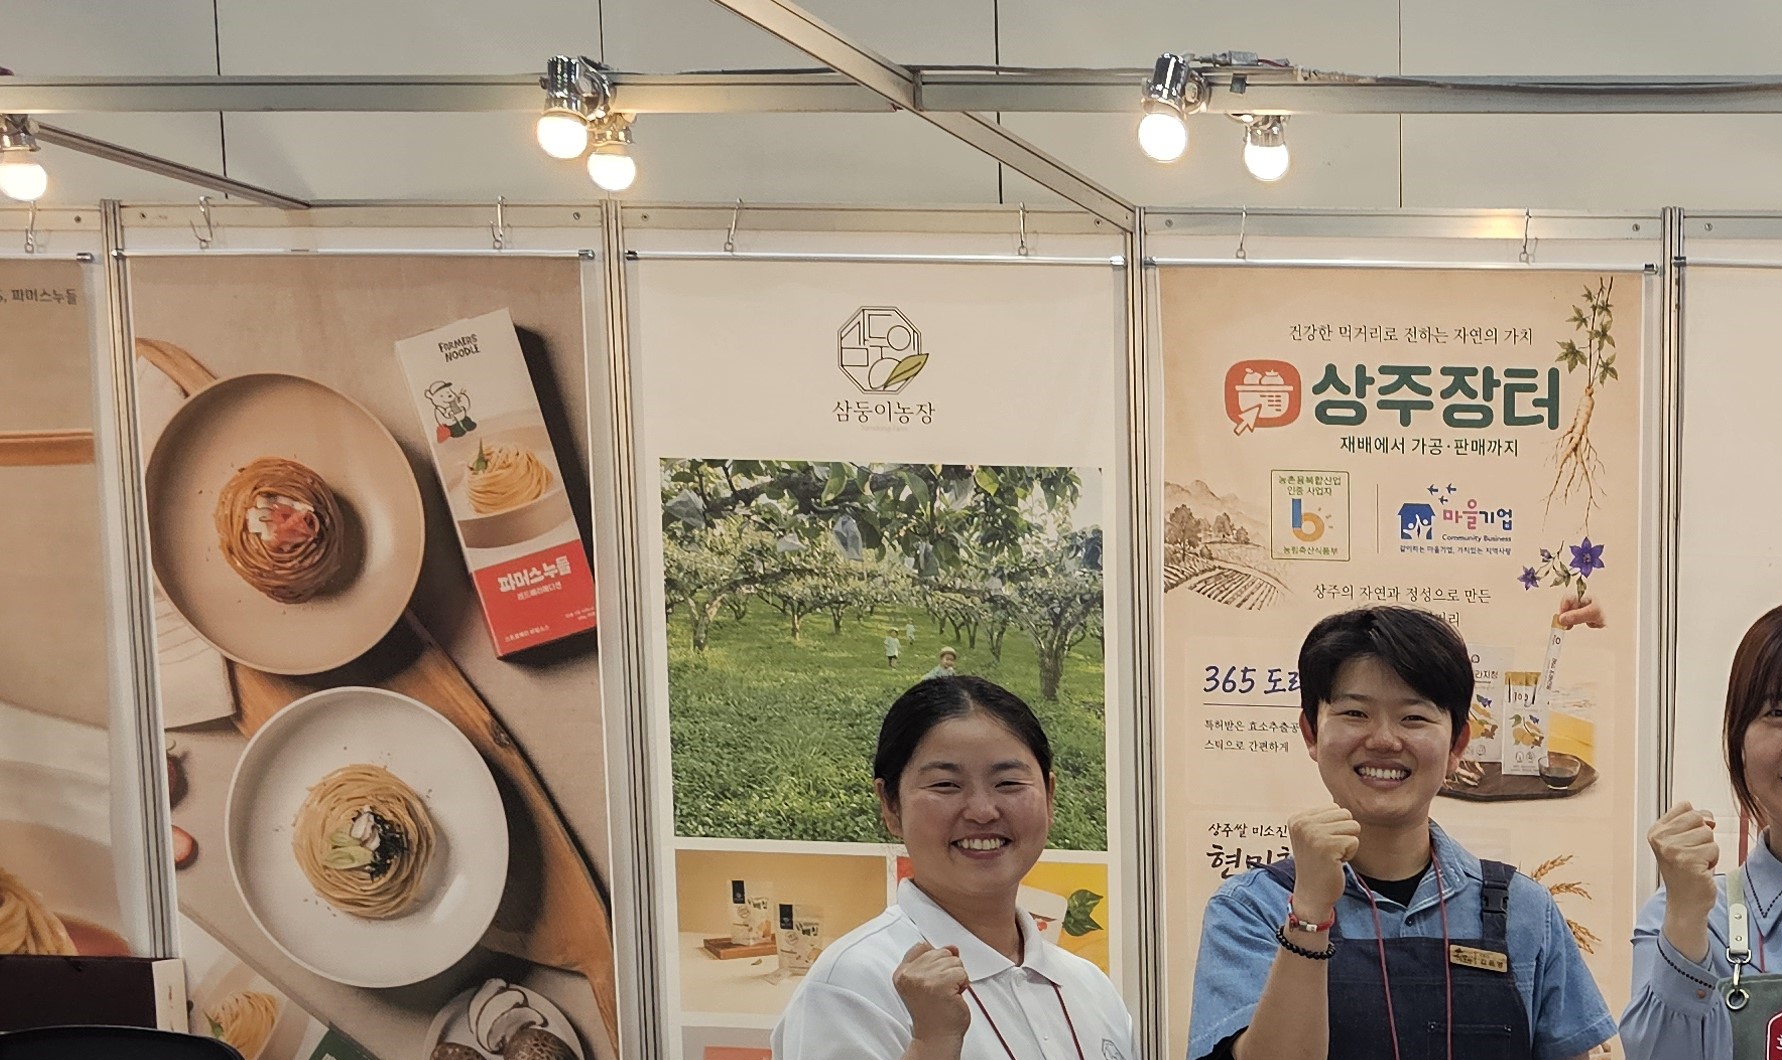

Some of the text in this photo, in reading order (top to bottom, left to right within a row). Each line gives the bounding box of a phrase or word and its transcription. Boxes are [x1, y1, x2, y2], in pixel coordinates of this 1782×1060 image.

[1289, 324, 1533, 346] 건강한 먹거리로 전하는 자연의 가치
[1312, 363, 1560, 431] 상주장터
[832, 400, 936, 425] 삼둥이농장
[1340, 436, 1405, 455] 재배에서
[1442, 498, 1513, 531] 마을기업
[1442, 534, 1481, 542] Community
[498, 556, 571, 592] 파머스누들
[1313, 583, 1492, 605] 상주의 자연과 정성으로 만든
[1203, 666, 1257, 694] 365
[1204, 739, 1289, 752] 스틱으로 간편하게
[1208, 823, 1248, 838] 상주쌀
